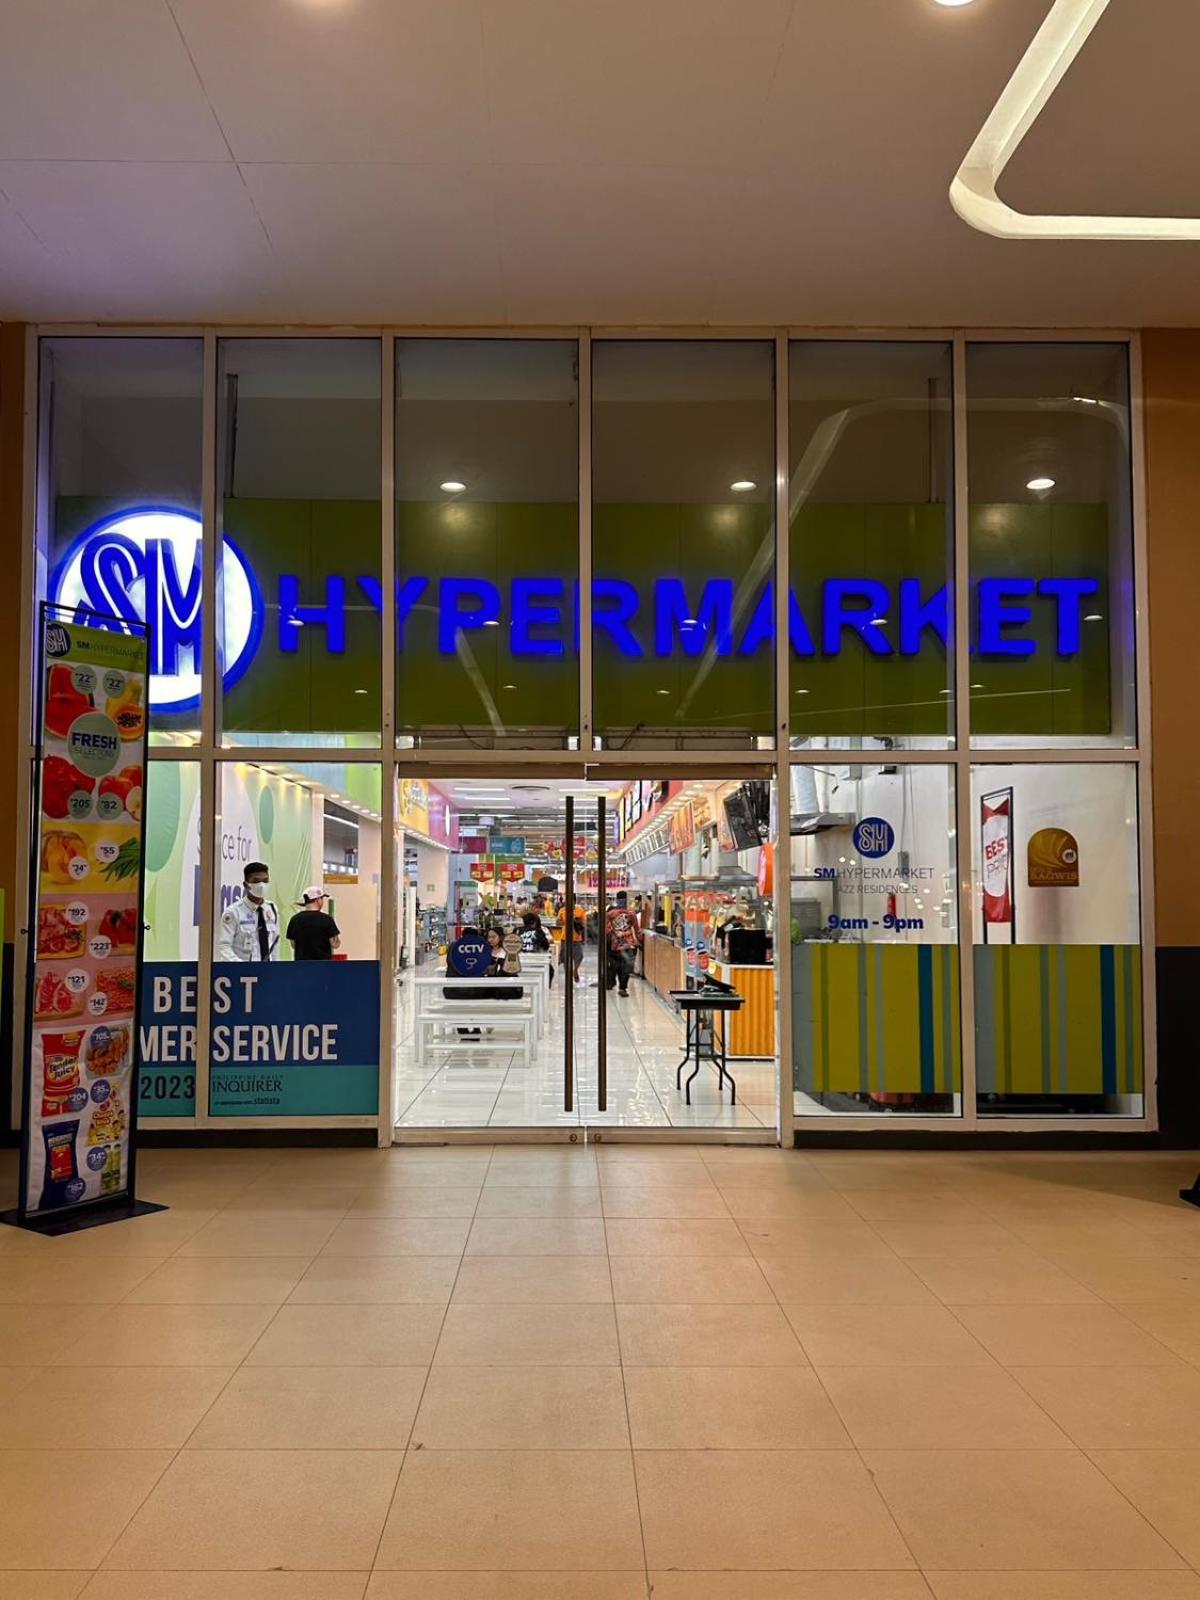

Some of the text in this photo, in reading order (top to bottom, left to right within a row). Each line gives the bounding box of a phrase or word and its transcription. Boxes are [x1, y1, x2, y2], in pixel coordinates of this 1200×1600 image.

[73, 533, 203, 675] SM
[278, 574, 1098, 656] HYPERMARKET
[72, 732, 117, 750] FRESH
[814, 867, 935, 879] SM HYPERMARKET
[828, 914, 868, 930] 9am
[883, 914, 924, 933] 9pm
[458, 944, 485, 954] CCTV
[153, 976, 258, 1014] BEST
[212, 1024, 338, 1062] SERVICE
[141, 1075, 196, 1100] 2023
[212, 1080, 283, 1093] INQUIRER
